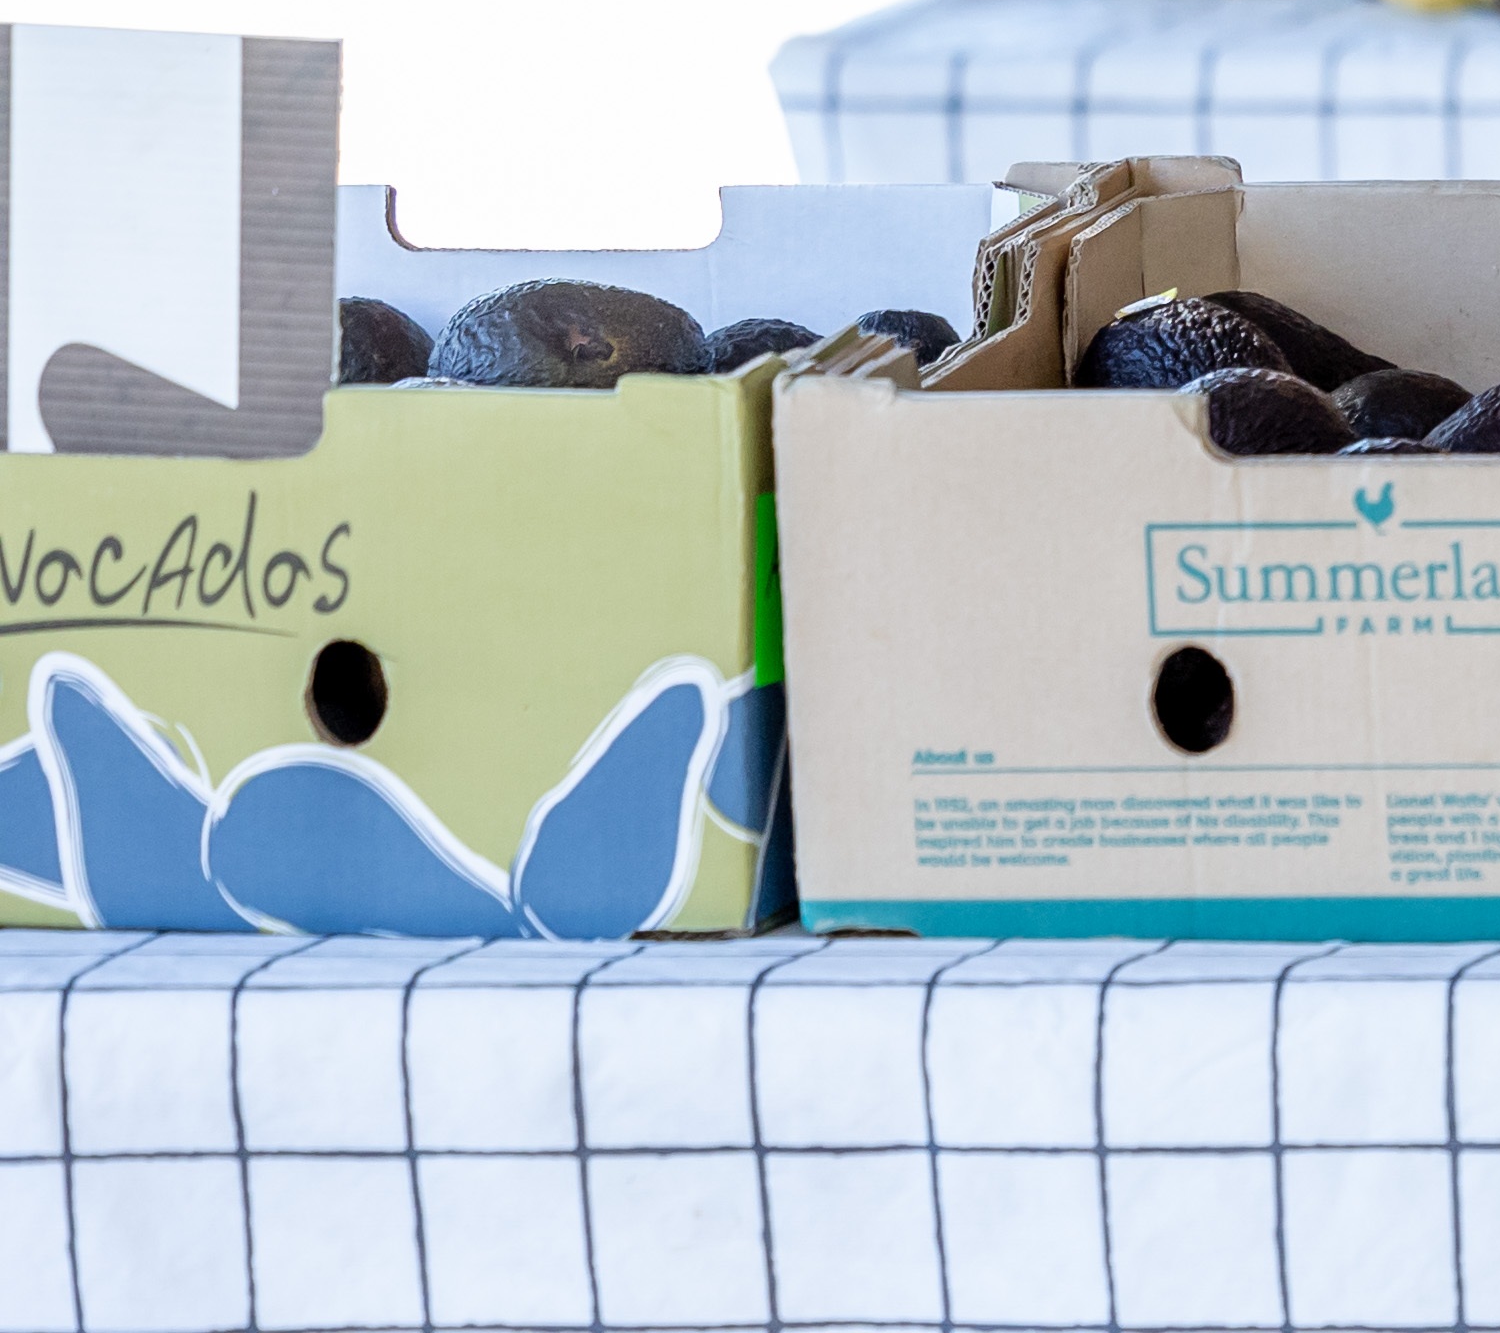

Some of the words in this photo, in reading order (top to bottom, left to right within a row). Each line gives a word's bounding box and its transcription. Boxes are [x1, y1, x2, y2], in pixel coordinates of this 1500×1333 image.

[1337, 616, 1434, 634] FARM
[912, 747, 967, 766] About
[974, 751, 995, 765] us
